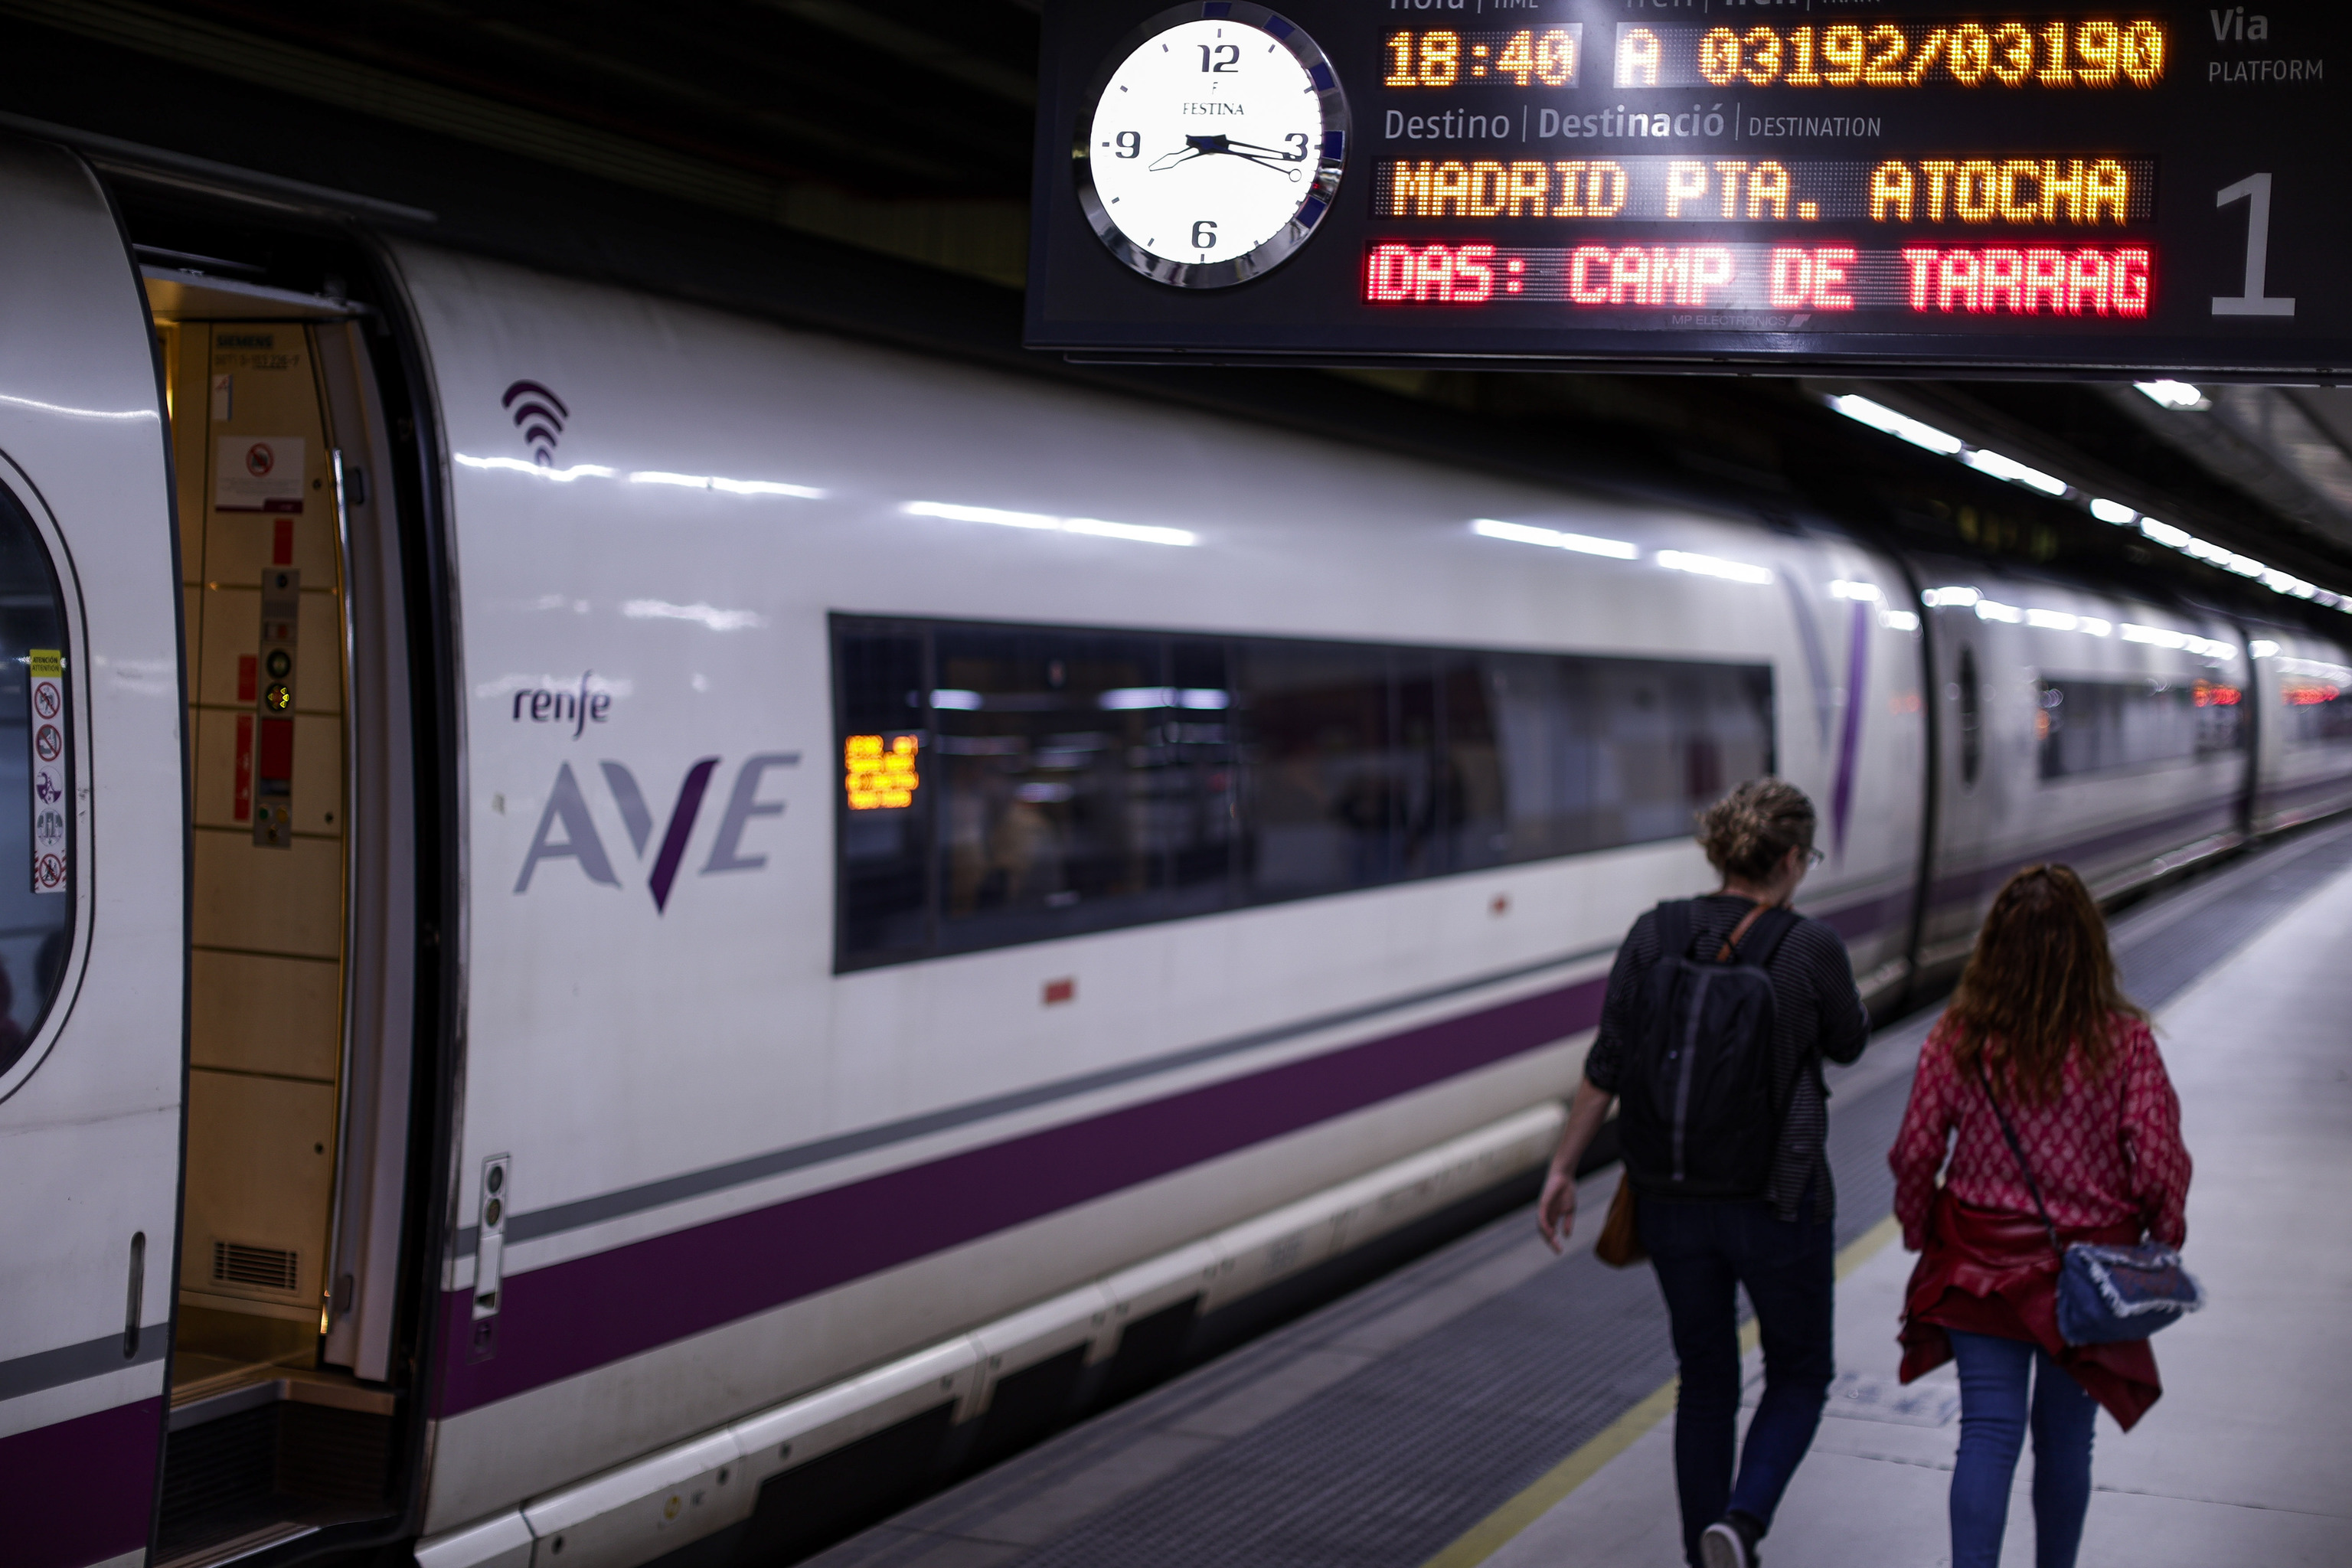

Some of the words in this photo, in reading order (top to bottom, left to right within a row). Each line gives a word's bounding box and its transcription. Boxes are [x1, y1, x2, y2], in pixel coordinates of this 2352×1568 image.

[2210, 8, 2269, 41] Via
[1197, 44, 1240, 73] 12
[1384, 29, 1574, 87] 18:40
[1618, 28, 1660, 86] A
[1699, 21, 2166, 88] 03192/03190
[2209, 59, 2323, 83] PLATFORM
[1183, 103, 1244, 115] FESTINA
[1385, 109, 1509, 139] Destino
[1539, 103, 1724, 137] Destinació
[1749, 116, 1880, 138] DESTINATION
[1115, 131, 1141, 158] 9
[1285, 132, 1308, 161] 3
[1392, 160, 1628, 218] MADRID
[1666, 160, 1819, 220] PTA.
[1870, 158, 2129, 223] ATOCHA
[1191, 220, 1217, 249] 6
[2211, 172, 2295, 316] 1
[1369, 244, 1523, 301] DAS:
[1569, 246, 1733, 307] CAMP
[1770, 247, 1856, 309] DE
[1903, 249, 2148, 315] TARRAG
[1672, 315, 1692, 325] MP
[1696, 315, 1786, 325] ELECTRONICS
[512, 669, 611, 741] renfe
[513, 750, 802, 917] AVE
